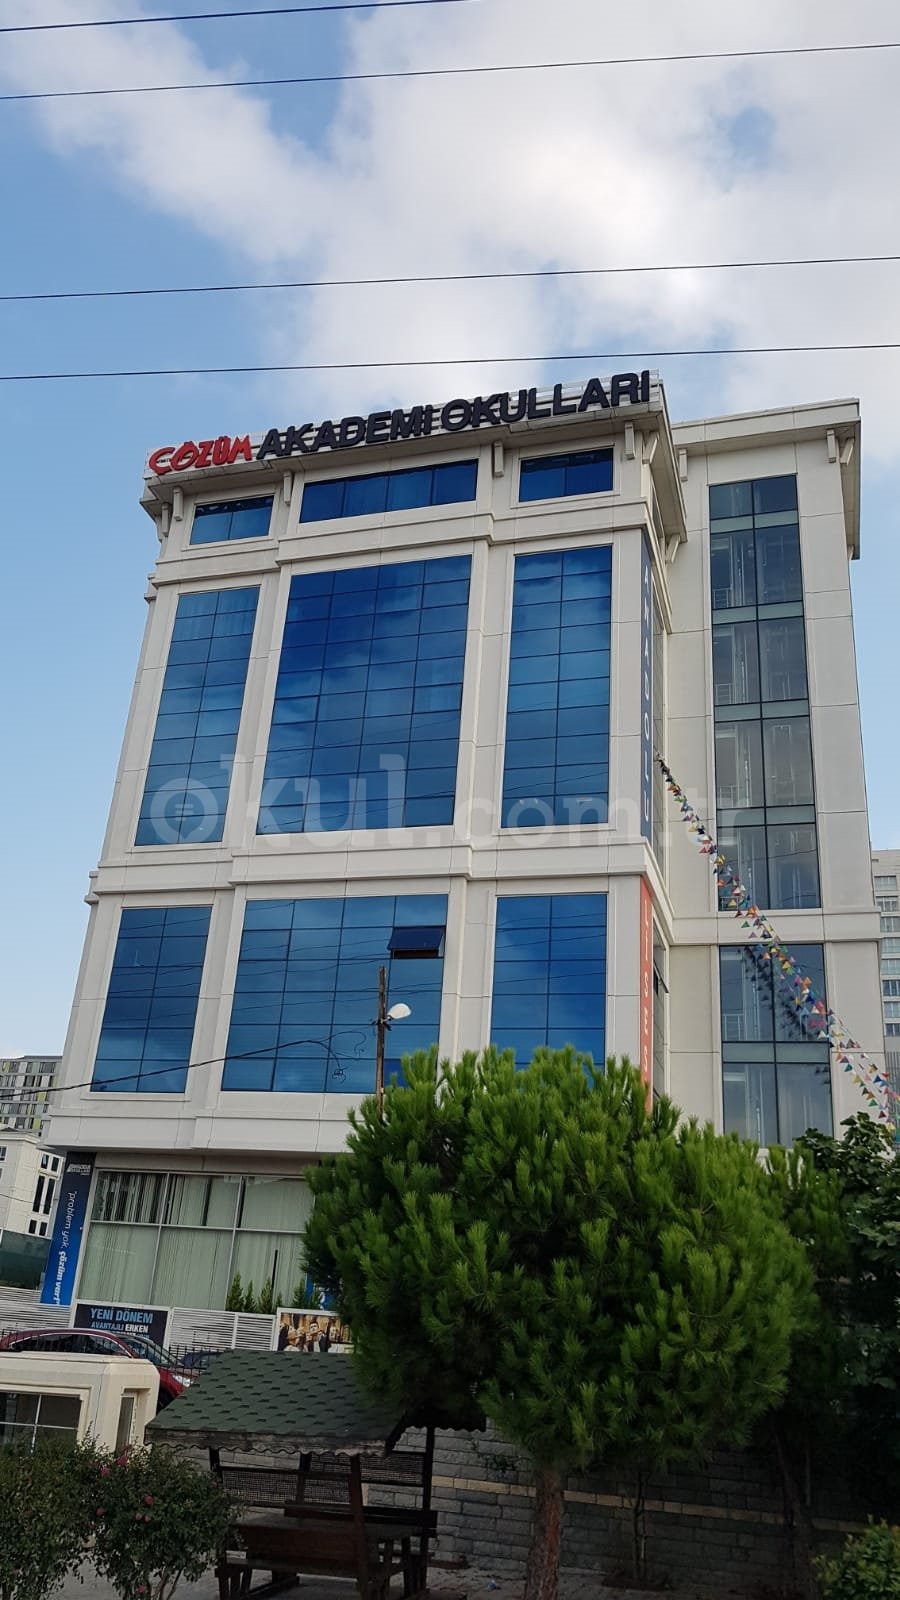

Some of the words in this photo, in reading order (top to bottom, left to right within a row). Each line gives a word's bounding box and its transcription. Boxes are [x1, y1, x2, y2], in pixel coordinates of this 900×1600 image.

[149, 435, 252, 475] ÇÖZÜM
[441, 370, 650, 431] OKULLARI
[116, 1307, 153, 1324] DÖNEM
[125, 1323, 149, 1333] ERKEN
